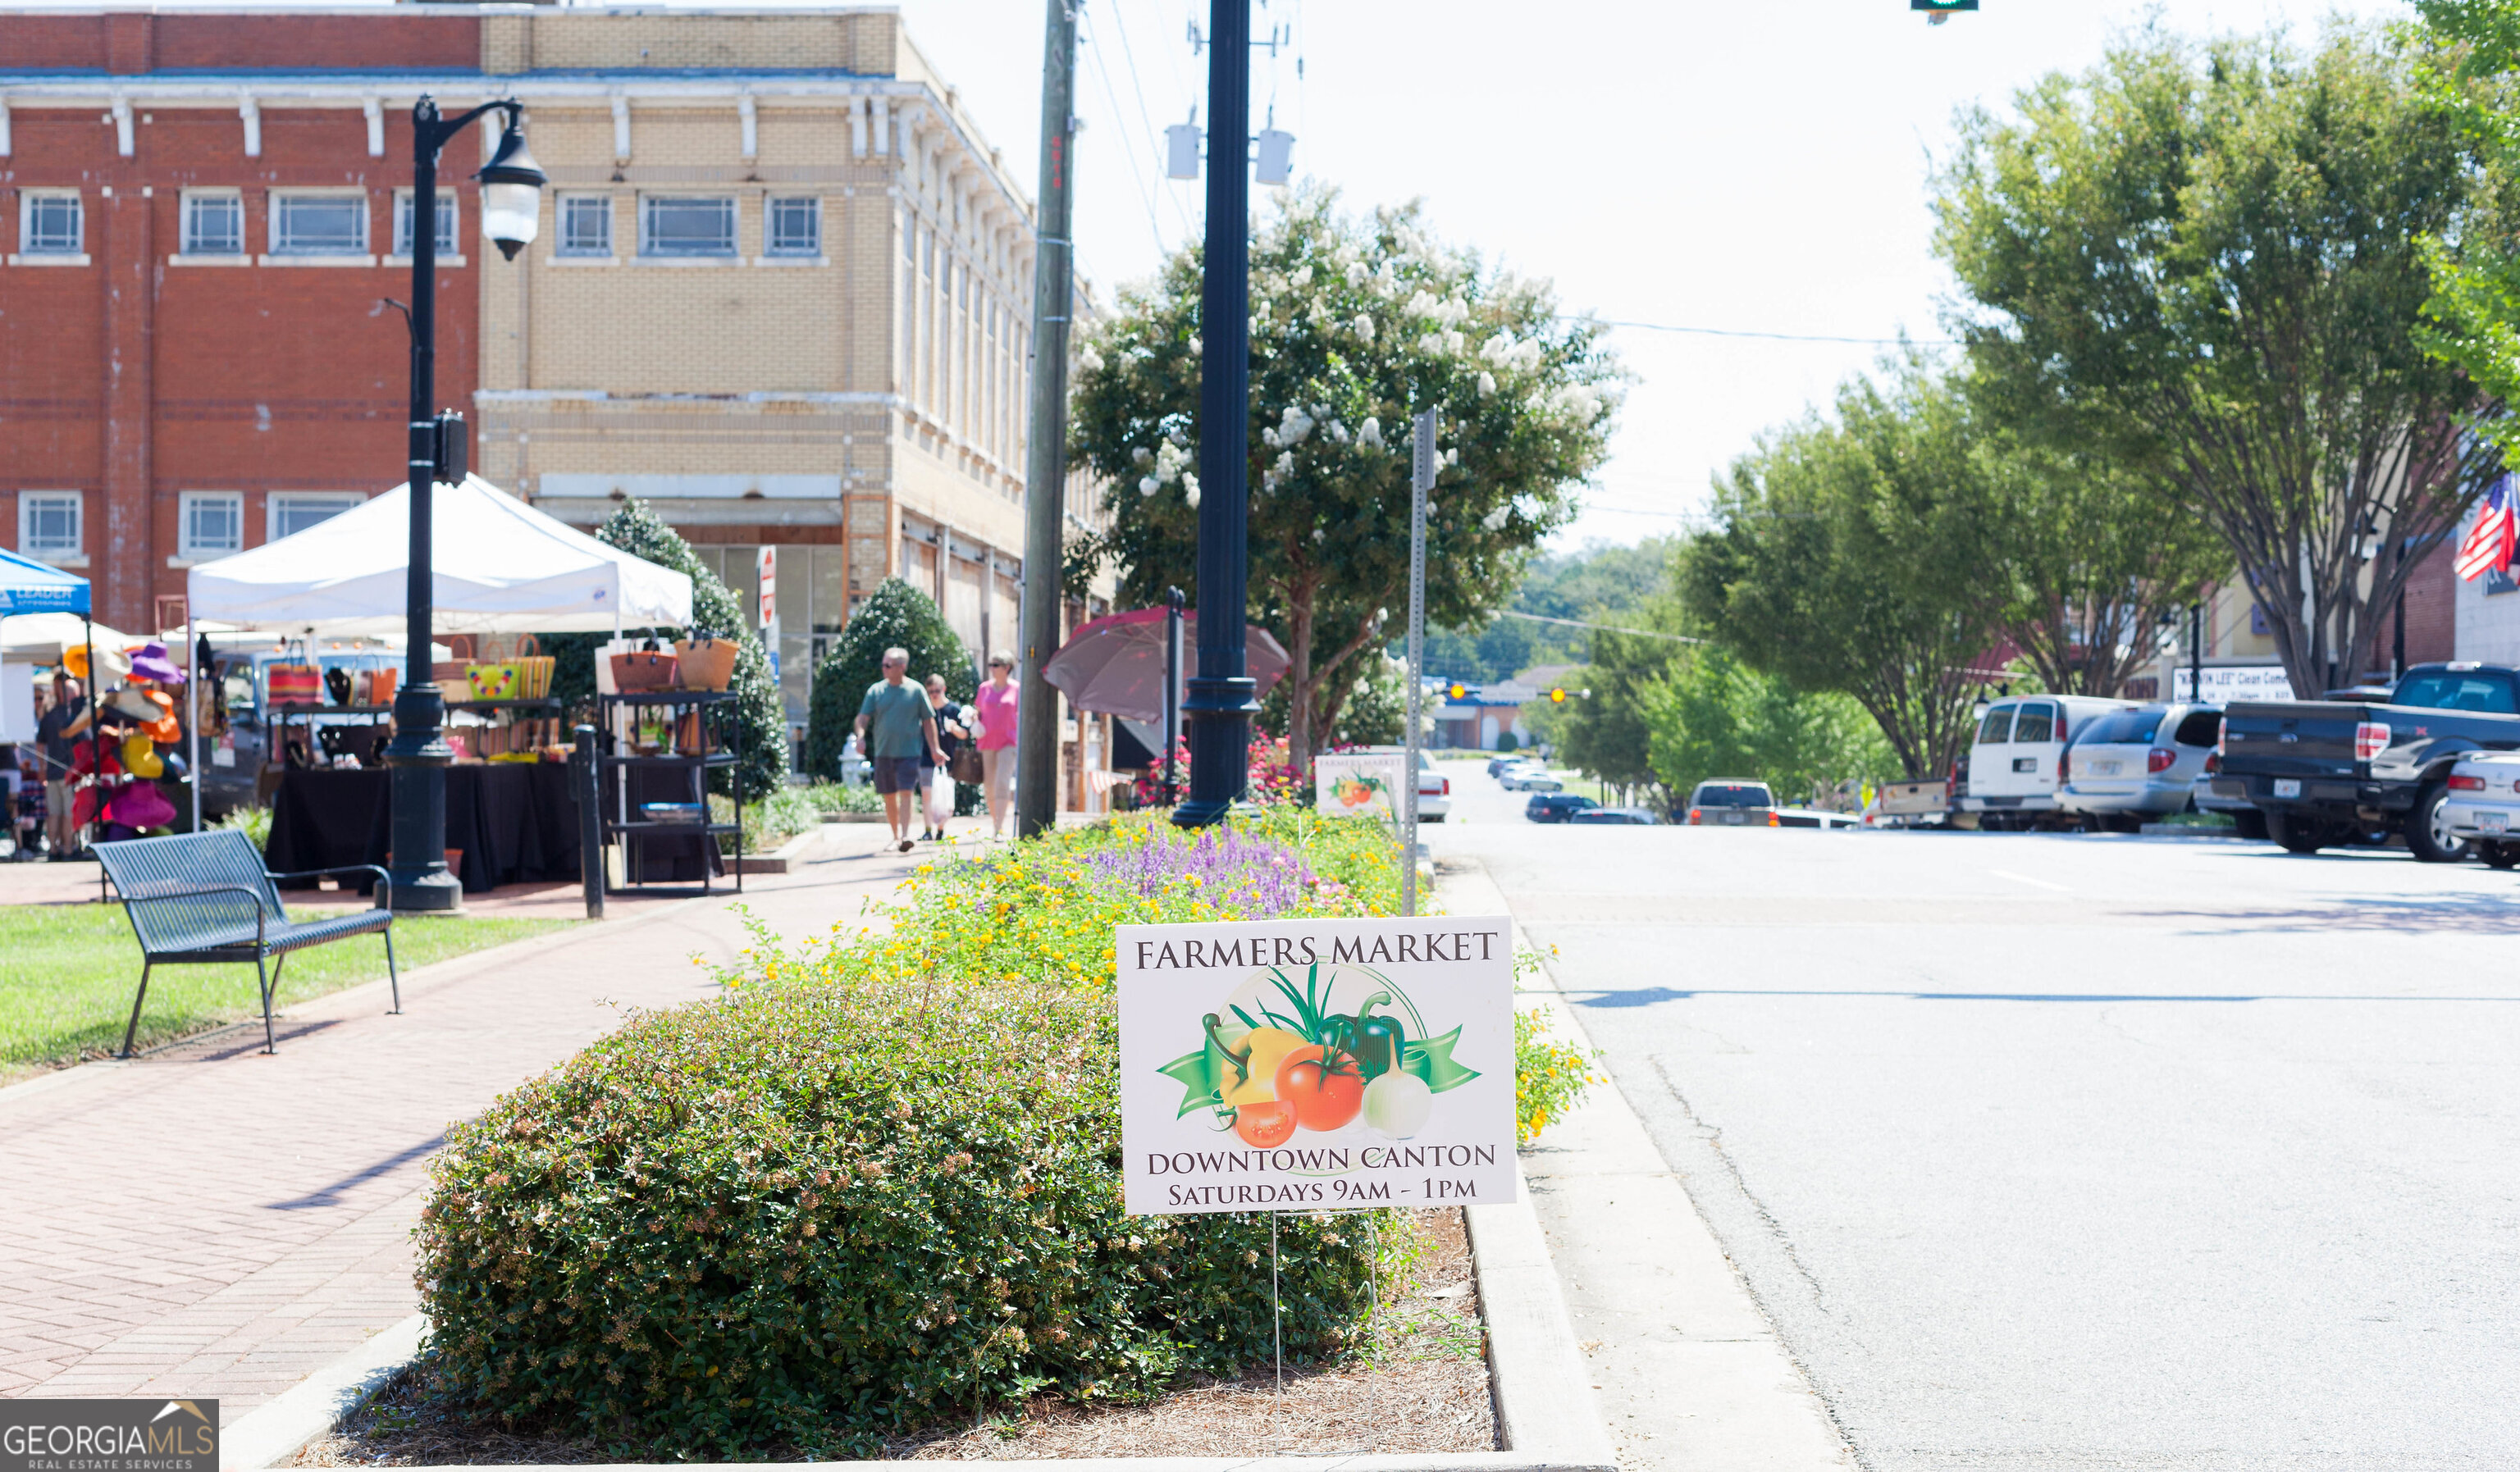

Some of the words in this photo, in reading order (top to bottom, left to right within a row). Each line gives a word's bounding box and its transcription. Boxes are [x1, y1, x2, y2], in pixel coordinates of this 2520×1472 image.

[1136, 937, 1316, 969] FARMERS
[1332, 932, 1498, 964] MARKET
[1148, 1149, 1349, 1175] DOWNTOWN
[1361, 1145, 1495, 1169] CANTON
[1169, 1183, 1323, 1206] SATURDAYS
[1333, 1180, 1390, 1201] 9AM
[1424, 1178, 1477, 1199] 1PM
